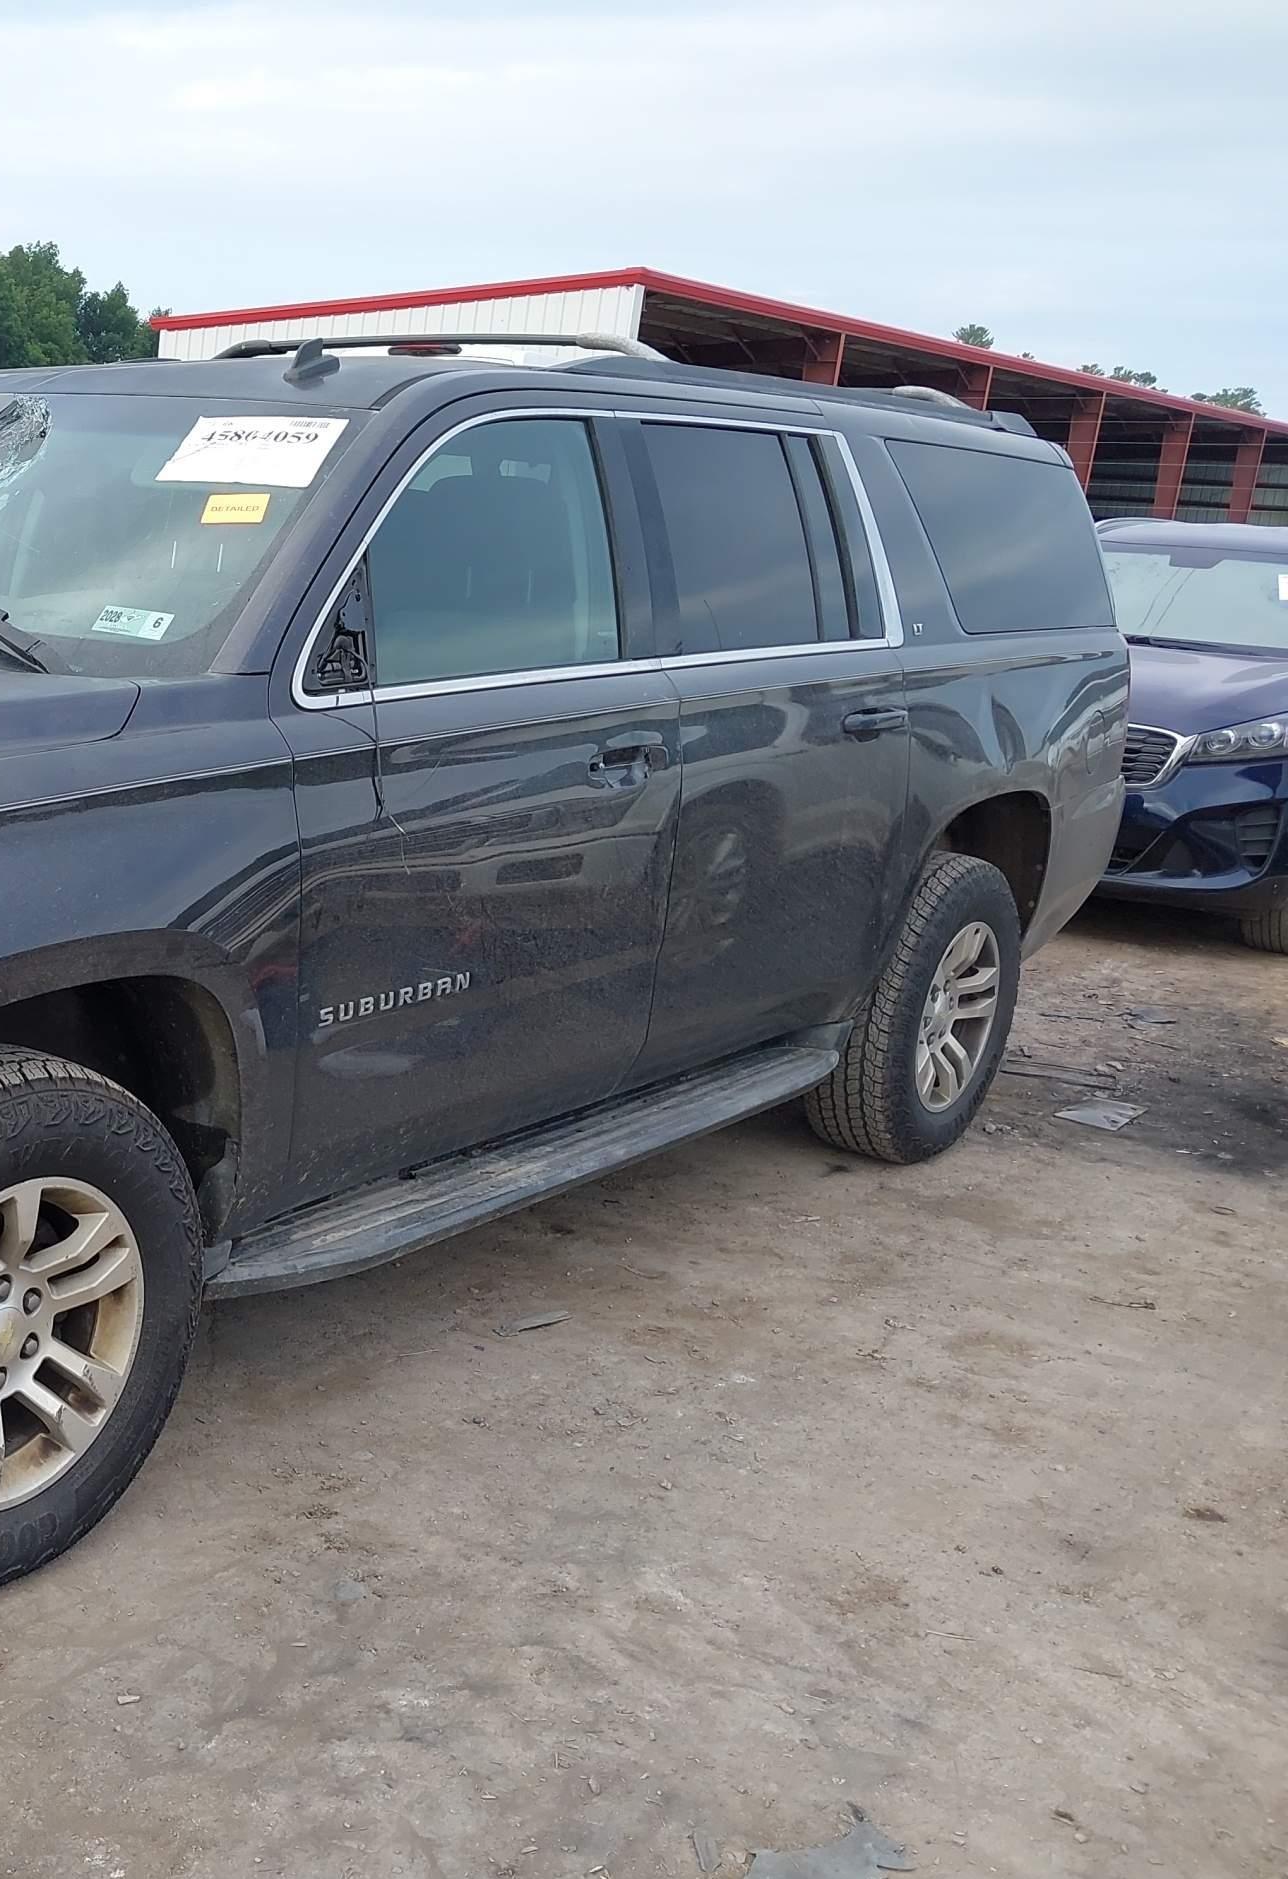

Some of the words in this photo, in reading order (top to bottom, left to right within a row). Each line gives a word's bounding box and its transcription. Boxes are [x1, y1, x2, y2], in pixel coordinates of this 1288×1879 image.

[201, 430, 320, 444] 45864059
[152, 617, 164, 629] 6
[318, 971, 470, 1027] SUBURBAN
